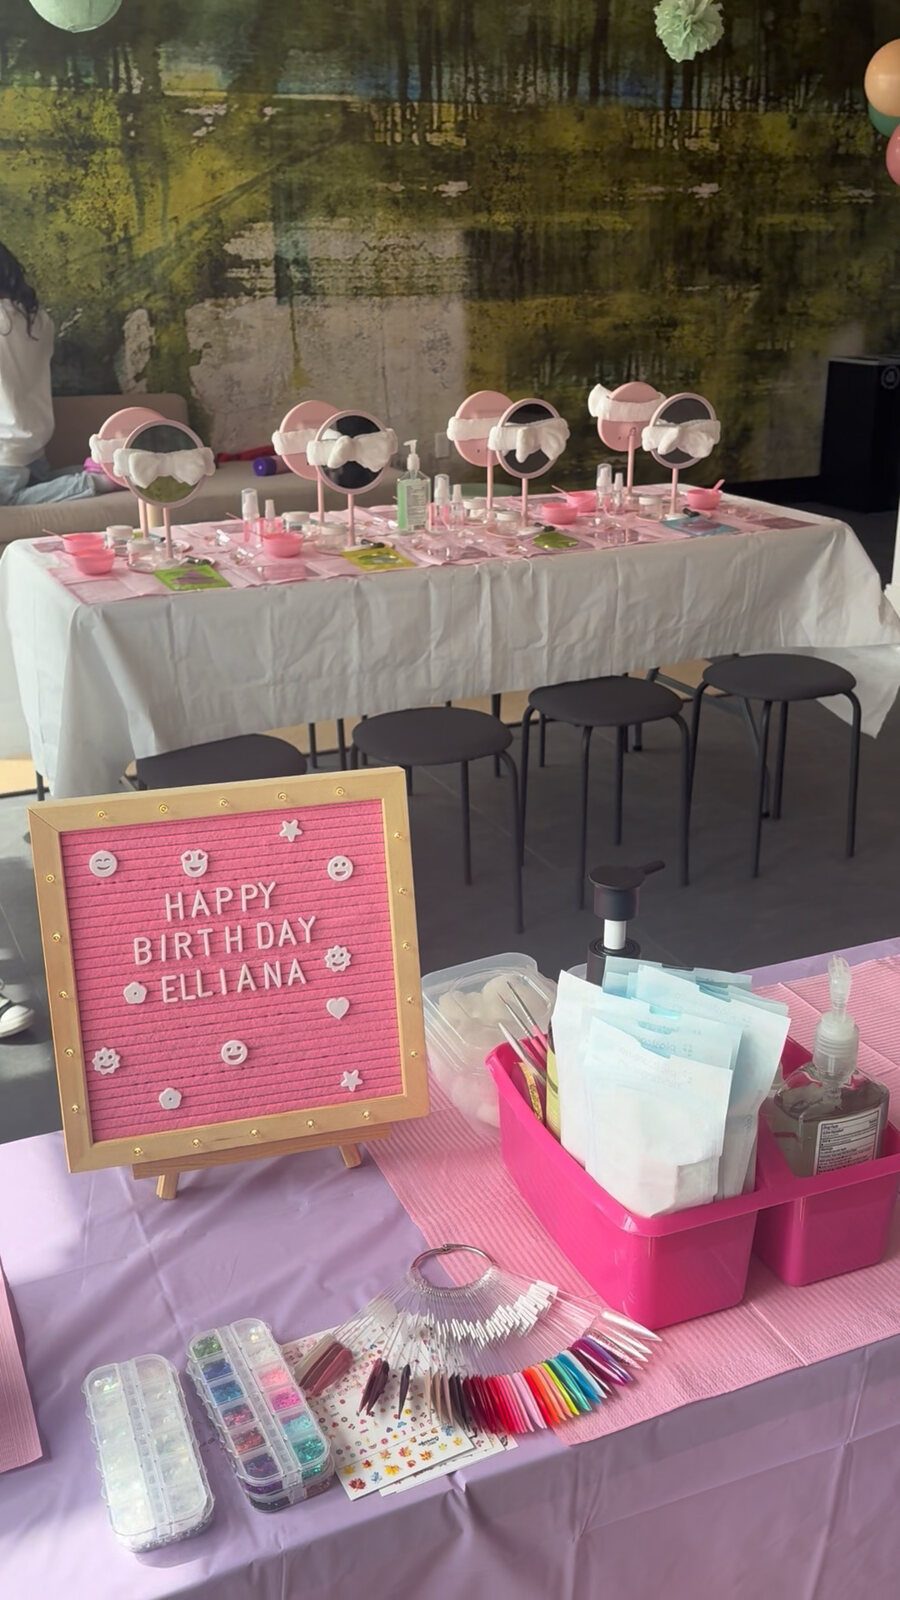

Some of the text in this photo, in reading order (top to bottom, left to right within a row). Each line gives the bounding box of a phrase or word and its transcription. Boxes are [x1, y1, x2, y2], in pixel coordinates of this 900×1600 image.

[164, 881, 277, 923] HAPPY
[133, 915, 317, 966] BIRTHDAY
[161, 958, 307, 1004] ELLIANA
